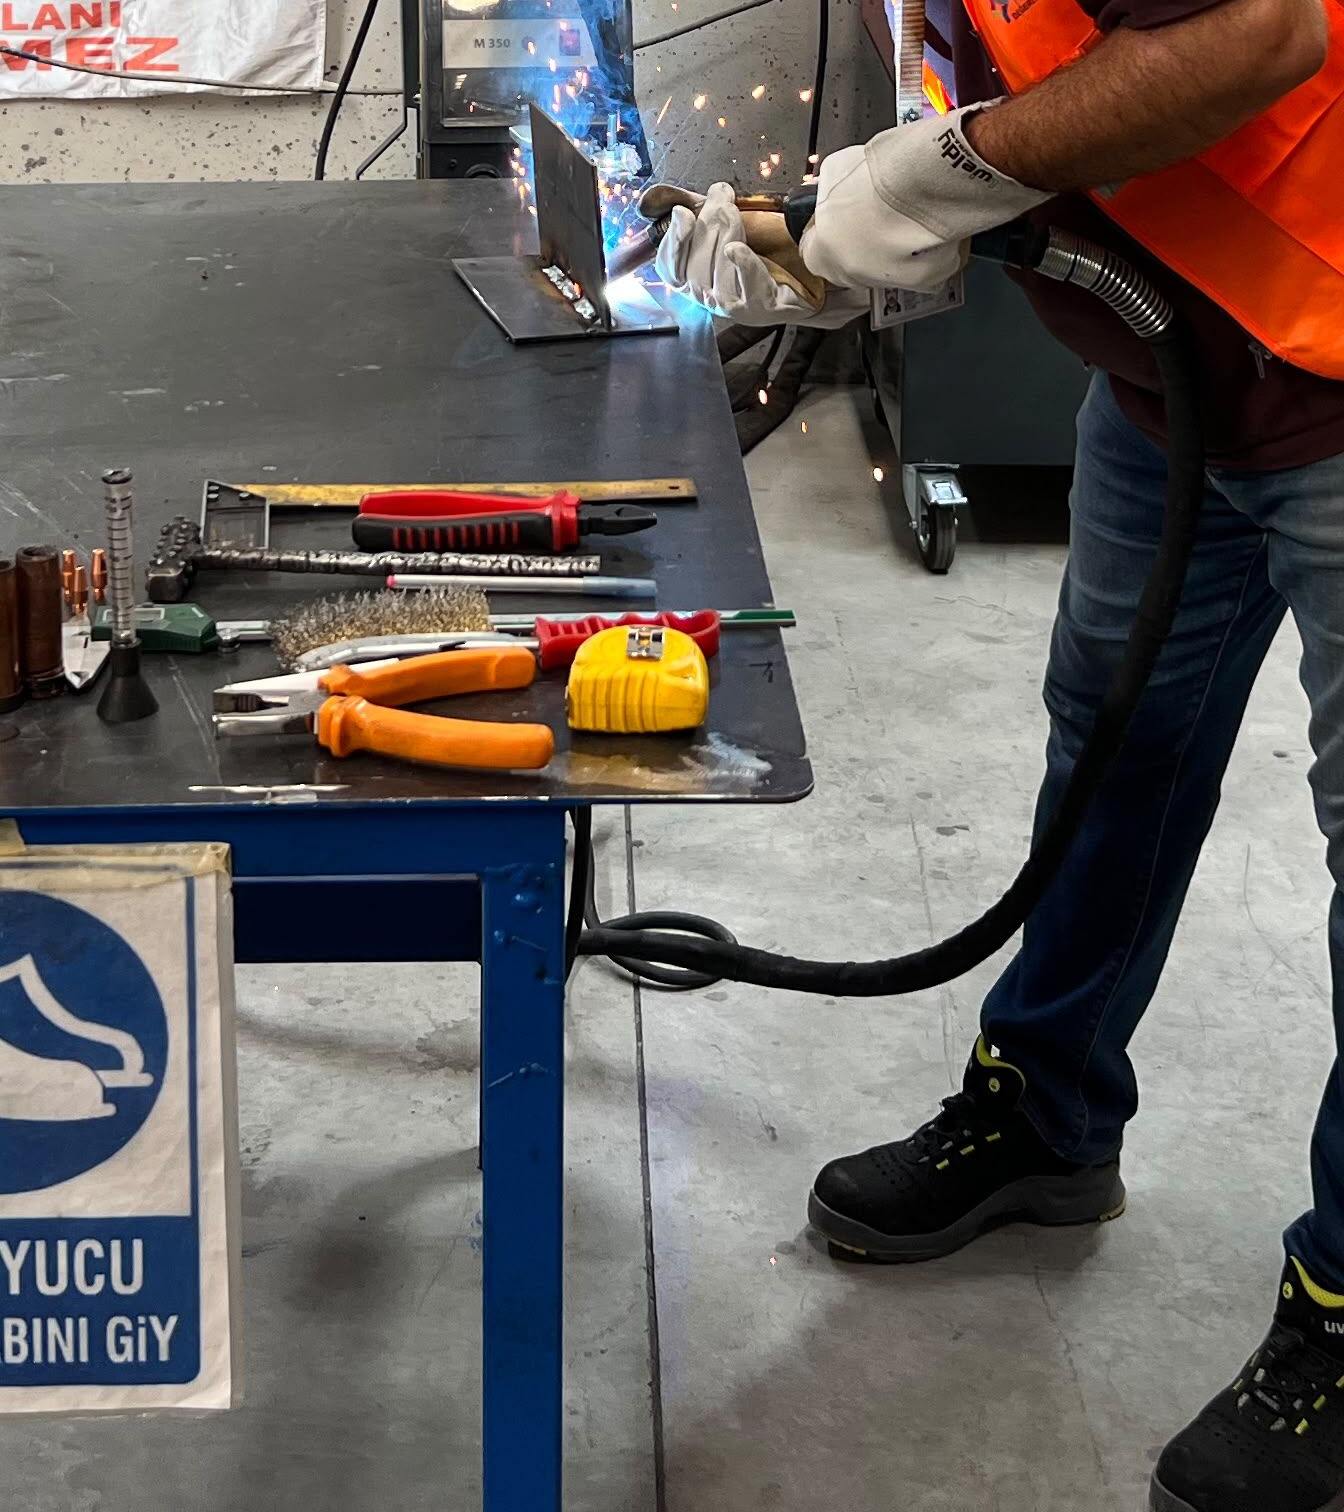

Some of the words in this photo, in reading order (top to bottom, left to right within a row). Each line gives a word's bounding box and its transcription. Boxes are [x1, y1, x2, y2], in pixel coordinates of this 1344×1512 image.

[473, 38, 486, 49] M
[488, 37, 511, 49] 350
[937, 127, 994, 183] weldy
